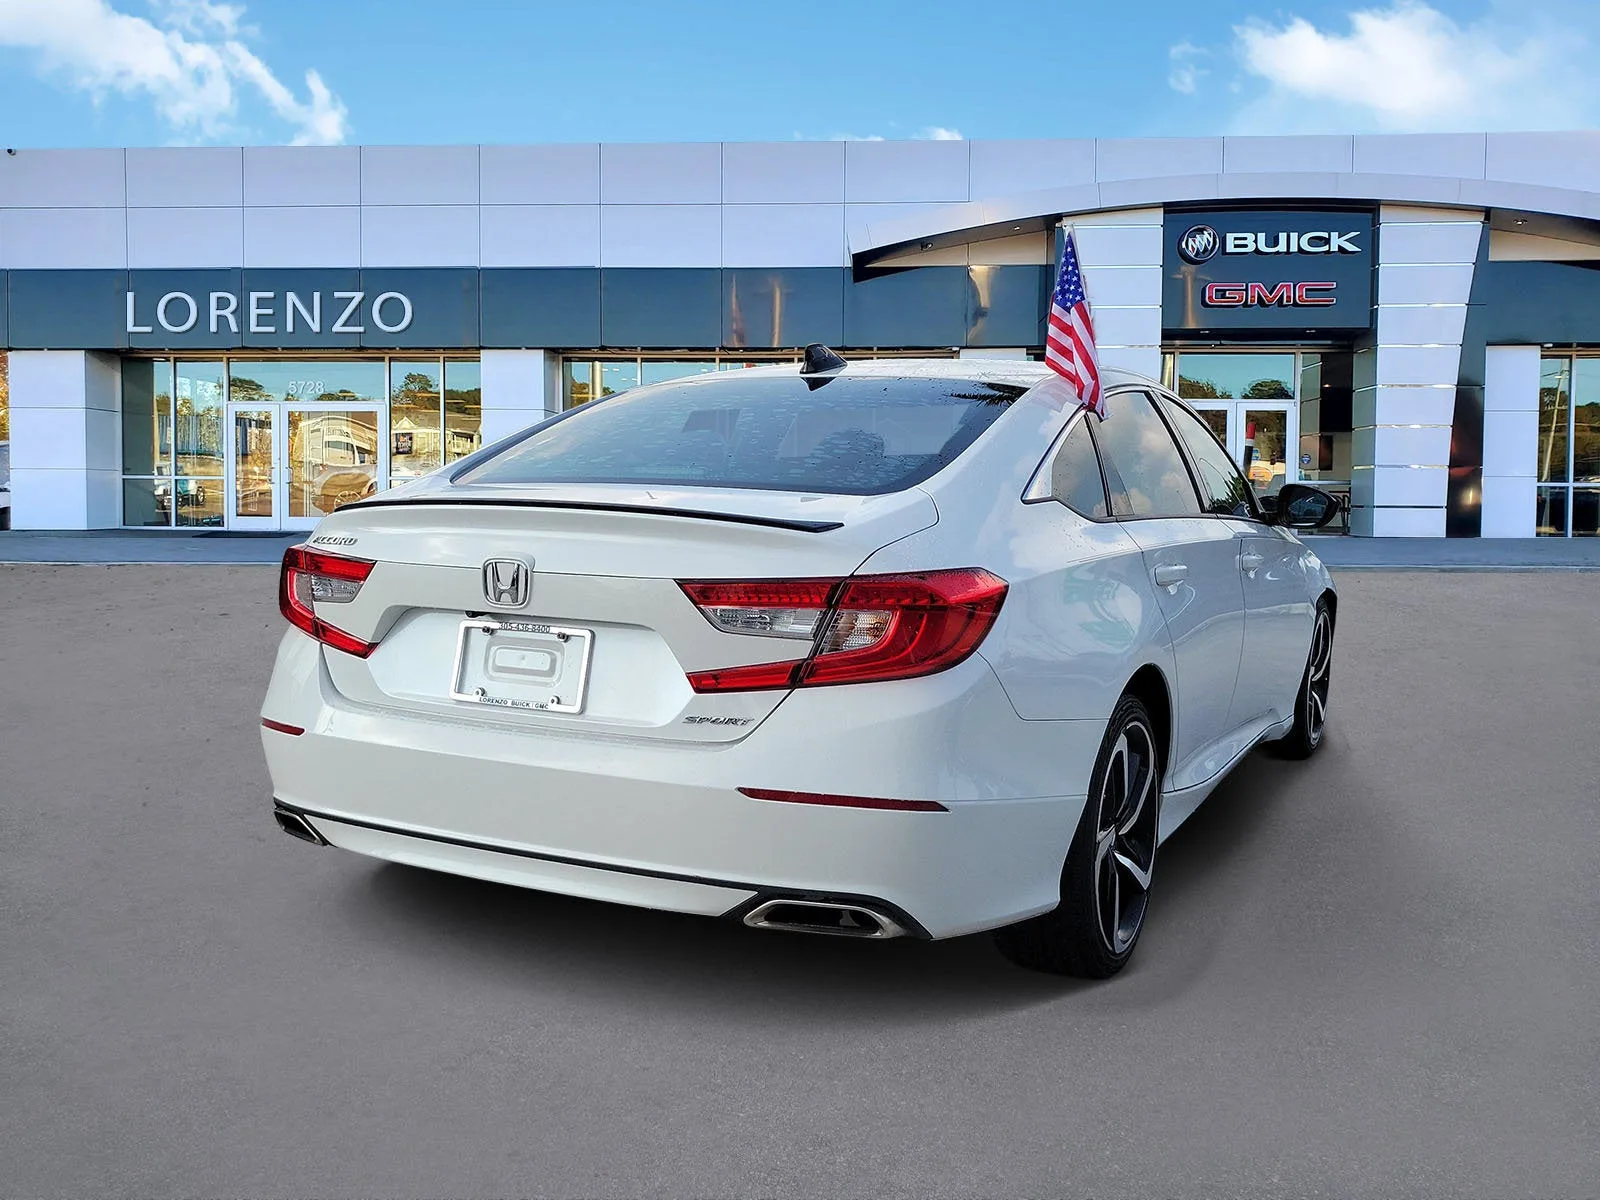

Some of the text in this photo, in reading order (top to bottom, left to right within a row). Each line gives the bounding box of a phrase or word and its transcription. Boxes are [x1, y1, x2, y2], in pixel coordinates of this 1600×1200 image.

[1224, 231, 1362, 253] BUICK
[1206, 281, 1337, 306] GMC
[126, 291, 413, 333] LORENZO
[288, 380, 326, 395] 5728
[312, 535, 359, 546] ACCORD
[479, 697, 549, 710] LORENZO BUICK GMC
[682, 715, 755, 726] SPORT
